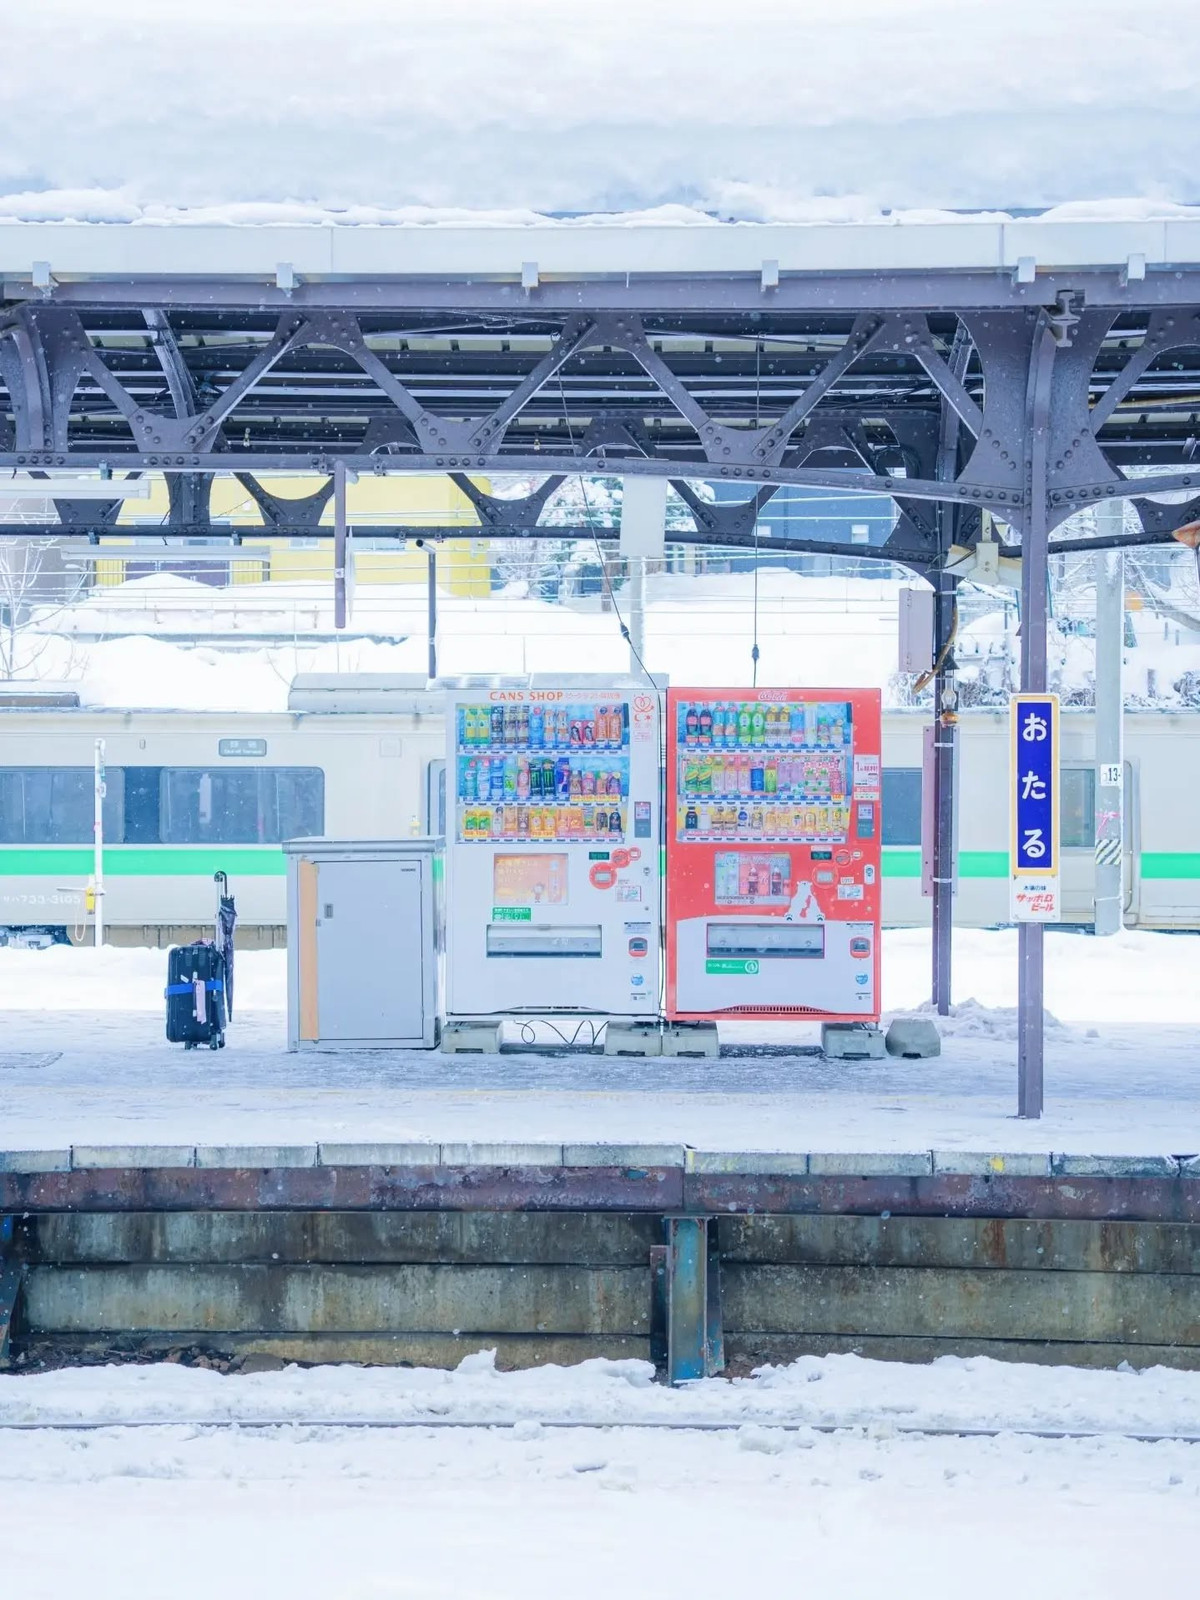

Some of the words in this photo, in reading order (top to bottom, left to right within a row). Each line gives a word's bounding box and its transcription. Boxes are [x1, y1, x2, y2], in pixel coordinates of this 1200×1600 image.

[490, 691, 524, 700] CANS
[529, 691, 563, 700] SHOP
[1022, 712, 1047, 858] おたる
[1016, 893, 1054, 903] サッポロ
[1031, 903, 1054, 912] ビール
